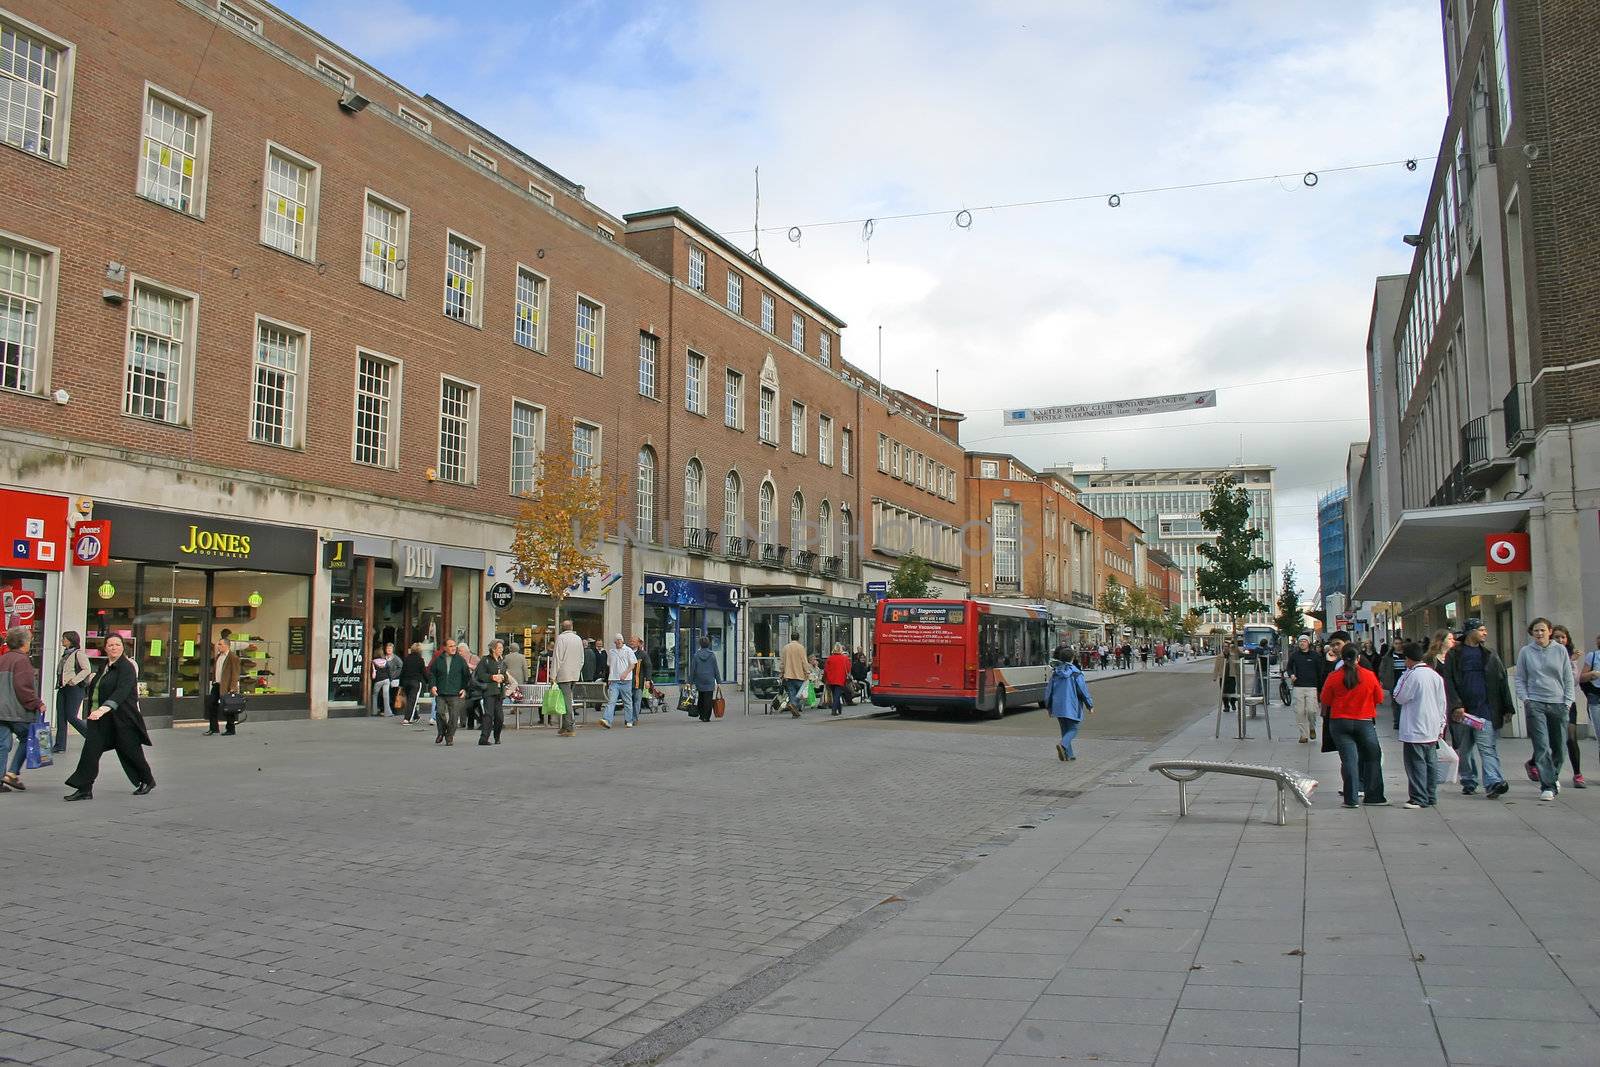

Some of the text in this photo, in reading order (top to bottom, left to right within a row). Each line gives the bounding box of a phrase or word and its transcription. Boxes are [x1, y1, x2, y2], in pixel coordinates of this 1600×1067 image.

[1033, 408, 1062, 416] EXETER
[1065, 405, 1090, 413] RUGBY
[1092, 403, 1113, 411] CLUB
[1115, 400, 1144, 408] SUNDAY
[30, 522, 38, 535] 3
[79, 526, 101, 535] phones
[180, 525, 251, 554] JONES
[404, 545, 435, 579] BAY
[332, 625, 363, 641] SALE
[331, 648, 363, 675] 70%
[353, 665, 362, 675] off
[332, 676, 349, 684] original
